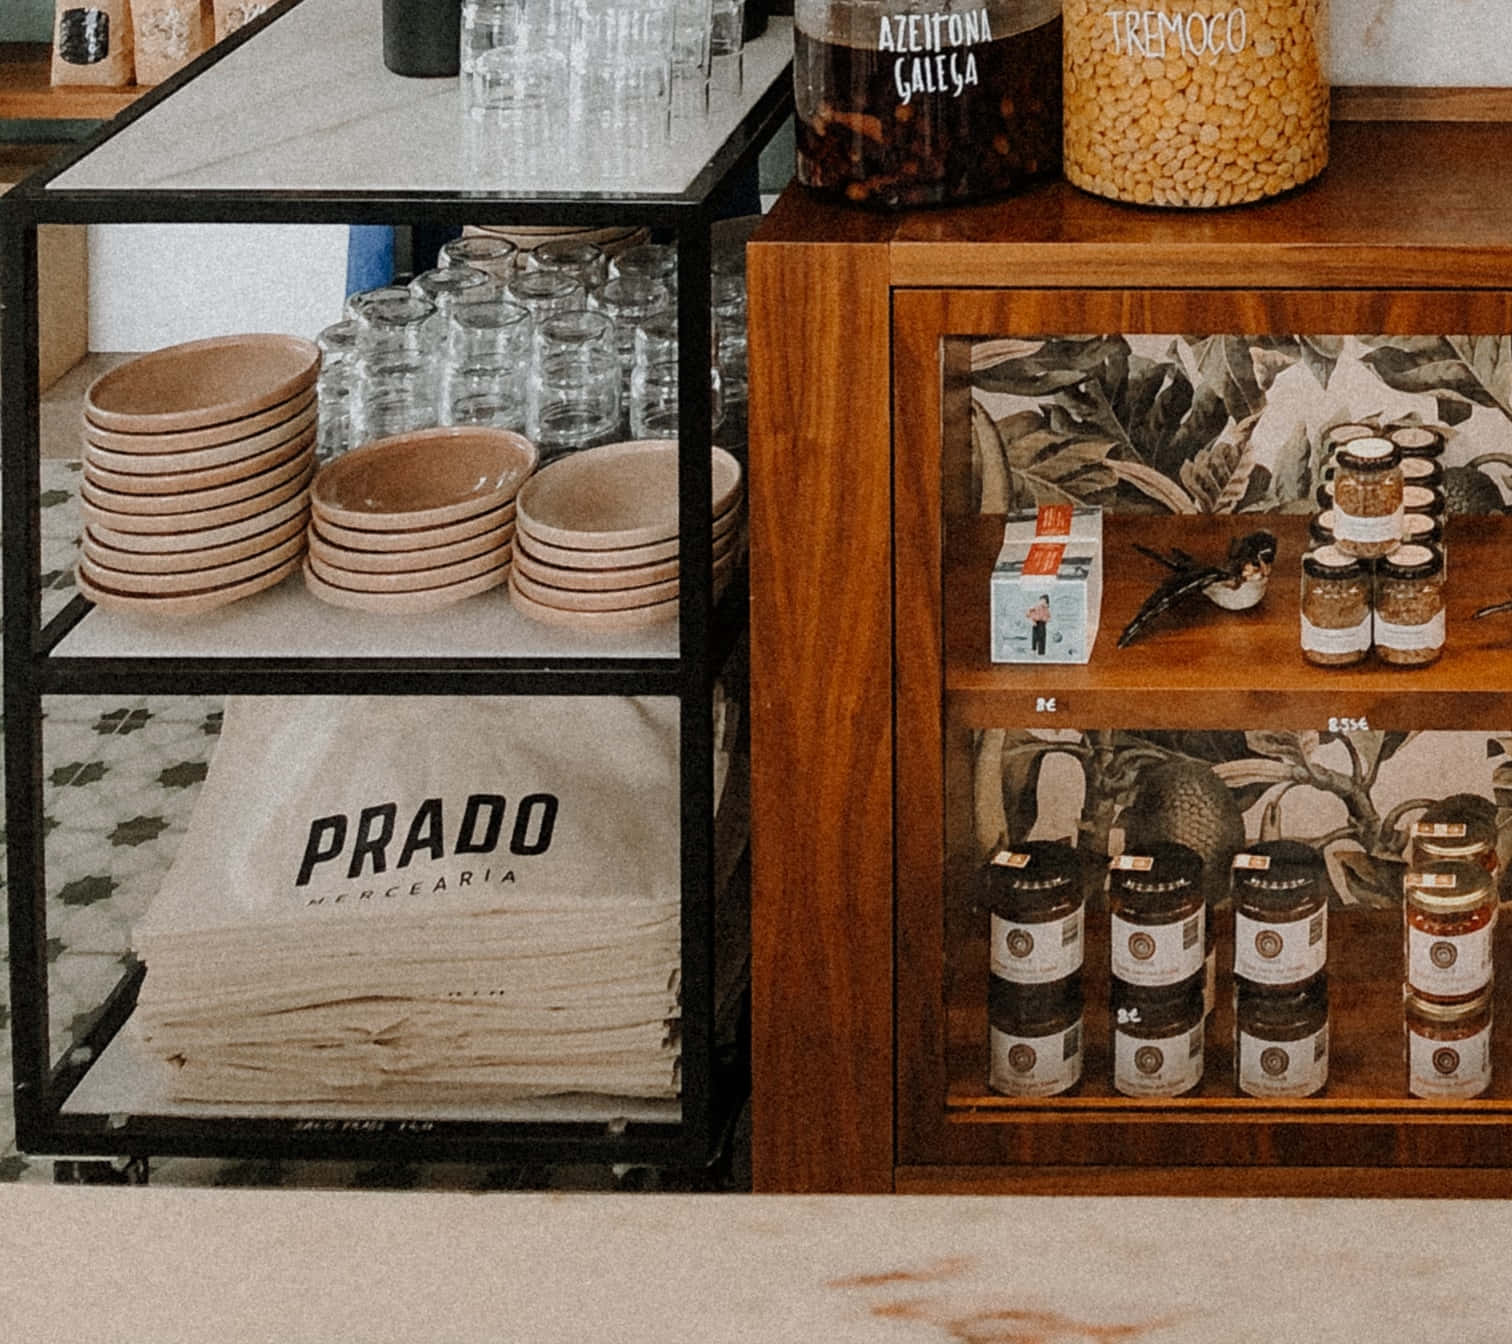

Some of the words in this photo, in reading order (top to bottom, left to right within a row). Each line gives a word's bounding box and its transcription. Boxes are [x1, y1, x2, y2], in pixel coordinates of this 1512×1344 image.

[877, 8, 994, 54] AZEITONA
[1105, 6, 1248, 66] TREMOÇO
[296, 793, 559, 888] PRADO
[305, 868, 517, 908] MERCEARIA
